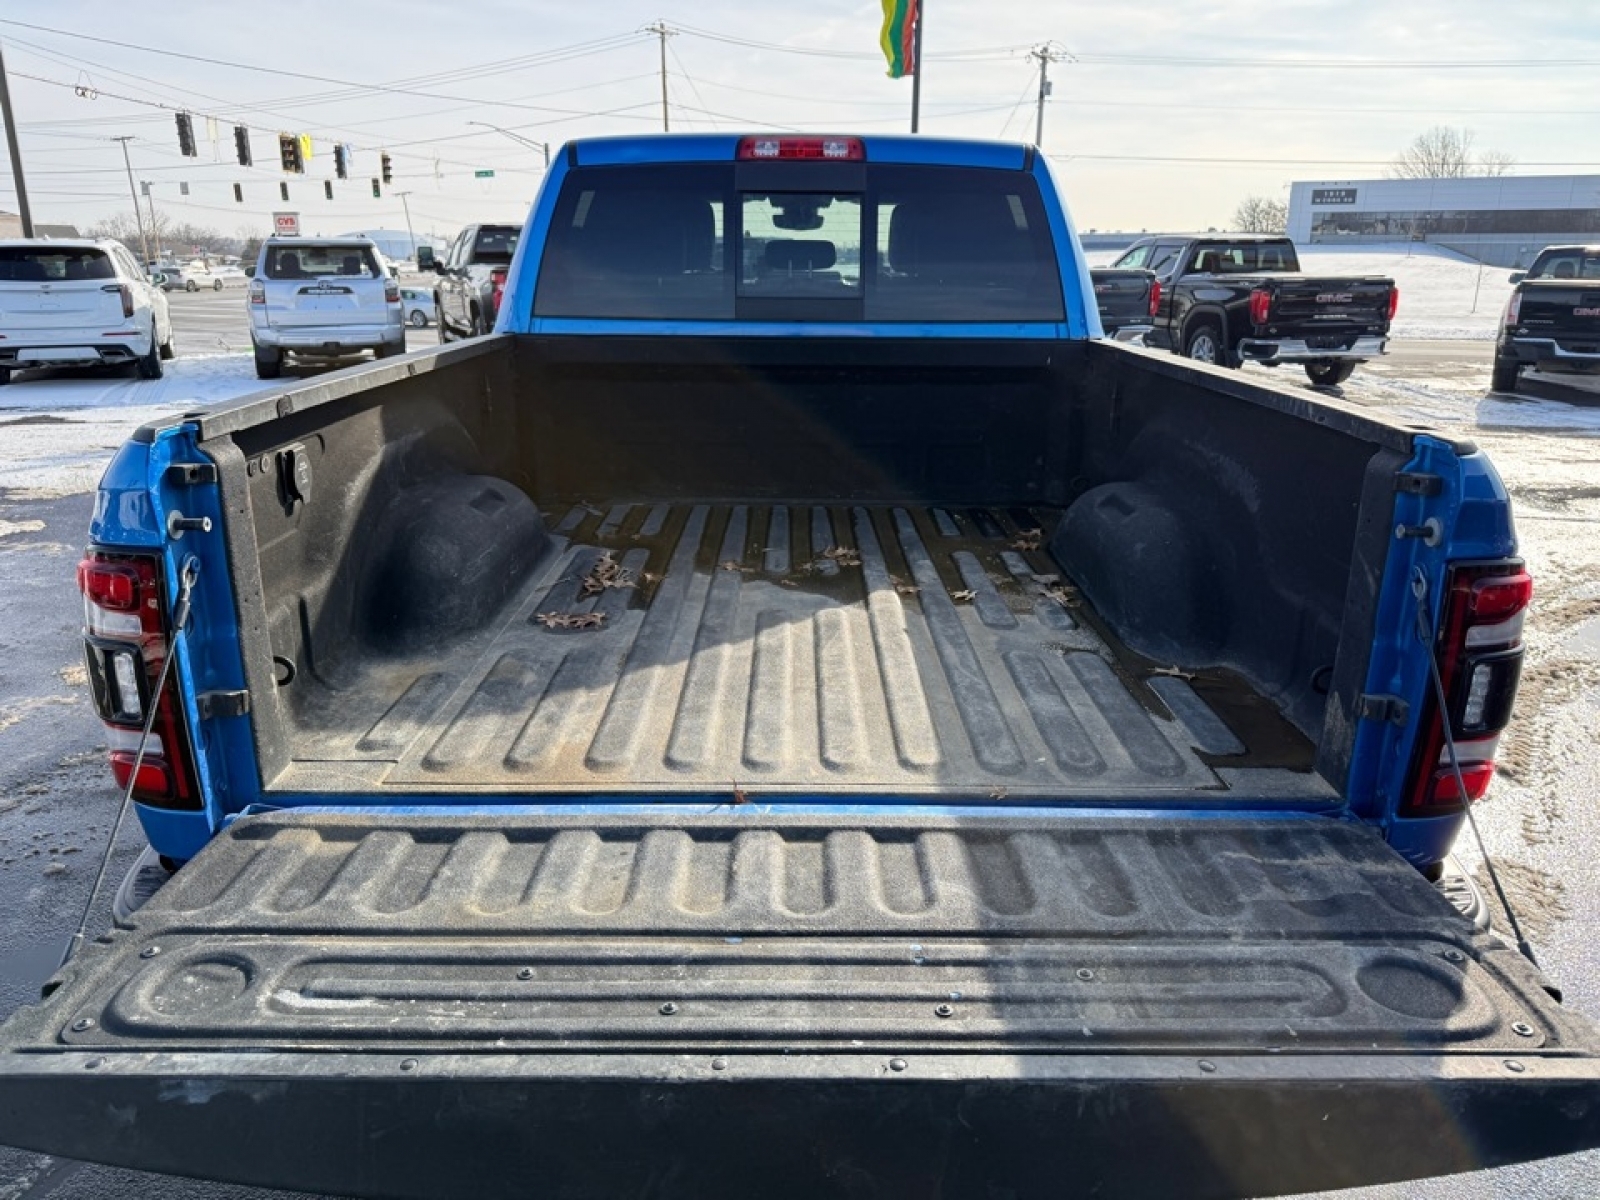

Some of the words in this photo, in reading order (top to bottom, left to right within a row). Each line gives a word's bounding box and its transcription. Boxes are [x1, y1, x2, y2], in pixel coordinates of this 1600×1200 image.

[277, 217, 295, 226] CVS
[1315, 293, 1353, 303] GMC
[1573, 307, 1600, 316] GM
